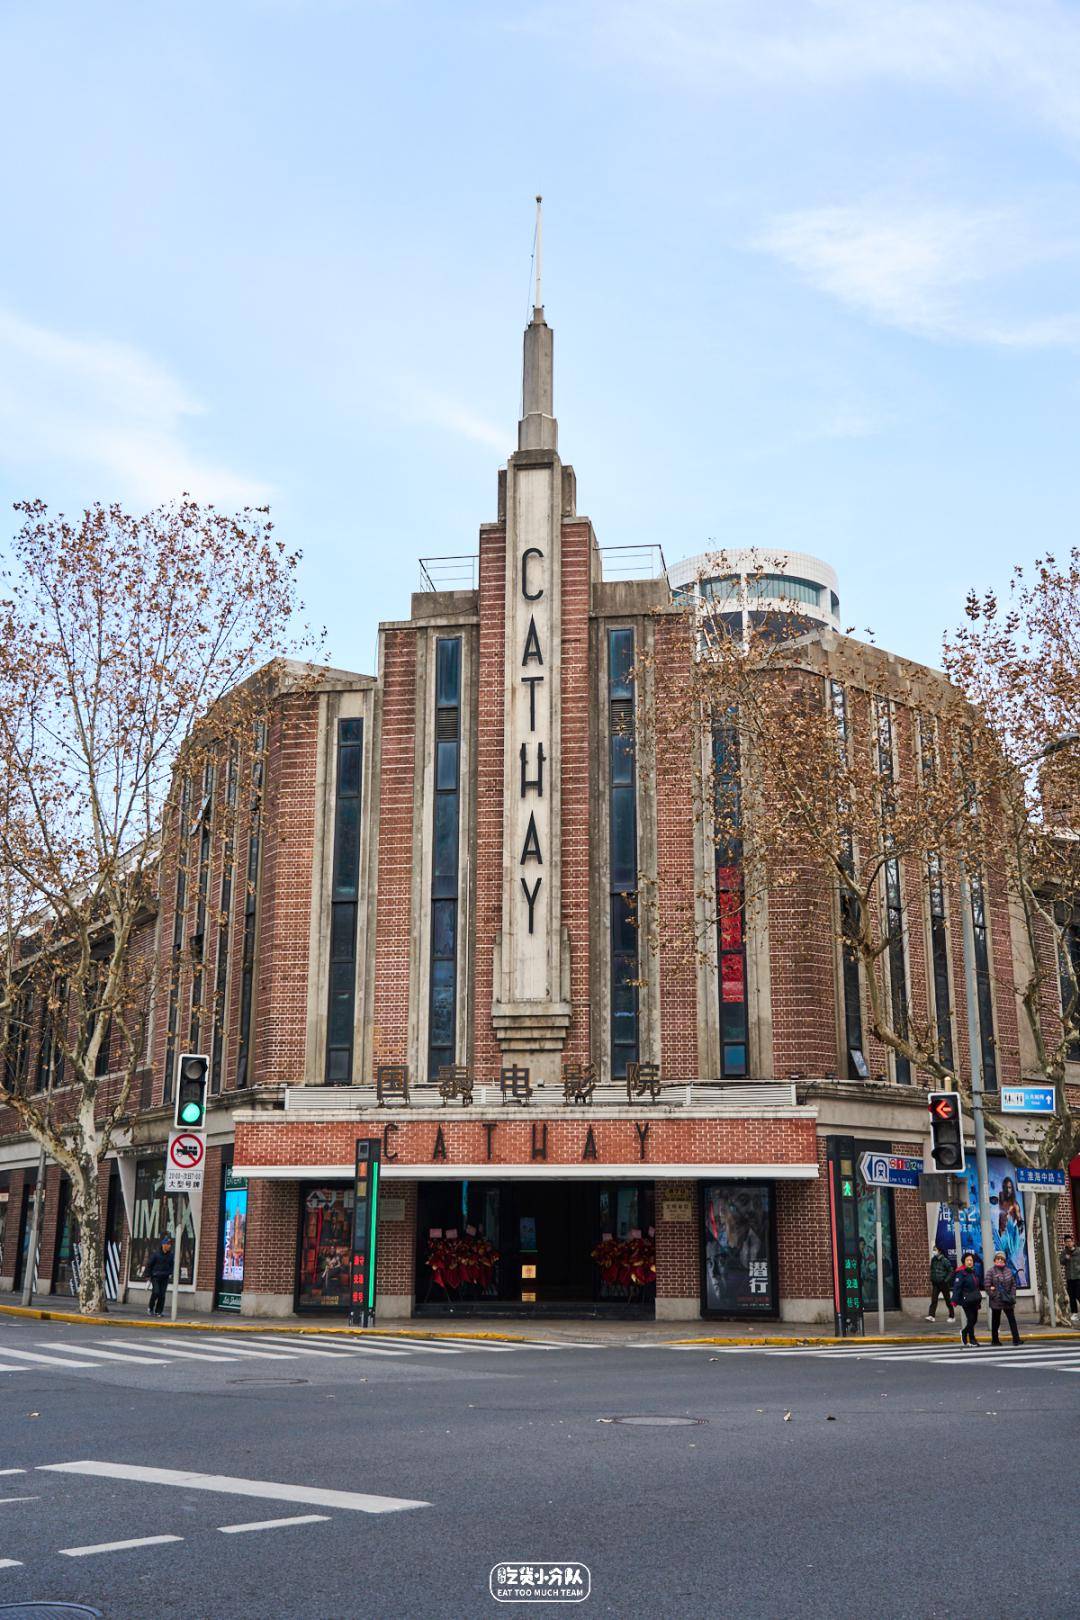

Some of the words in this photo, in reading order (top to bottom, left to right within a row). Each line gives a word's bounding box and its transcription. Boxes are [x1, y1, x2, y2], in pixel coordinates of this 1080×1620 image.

[519, 547, 546, 935] CATHAY
[376, 1060, 662, 1099] 国泰电影院
[383, 1121, 650, 1161] CATHAY
[1027, 1170, 1055, 1183] 淮海中路
[133, 1197, 195, 1239] IMAX
[748, 1262, 768, 1293] 潜行
[846, 1279, 859, 1289] 交通
[847, 1297, 861, 1308] 信号
